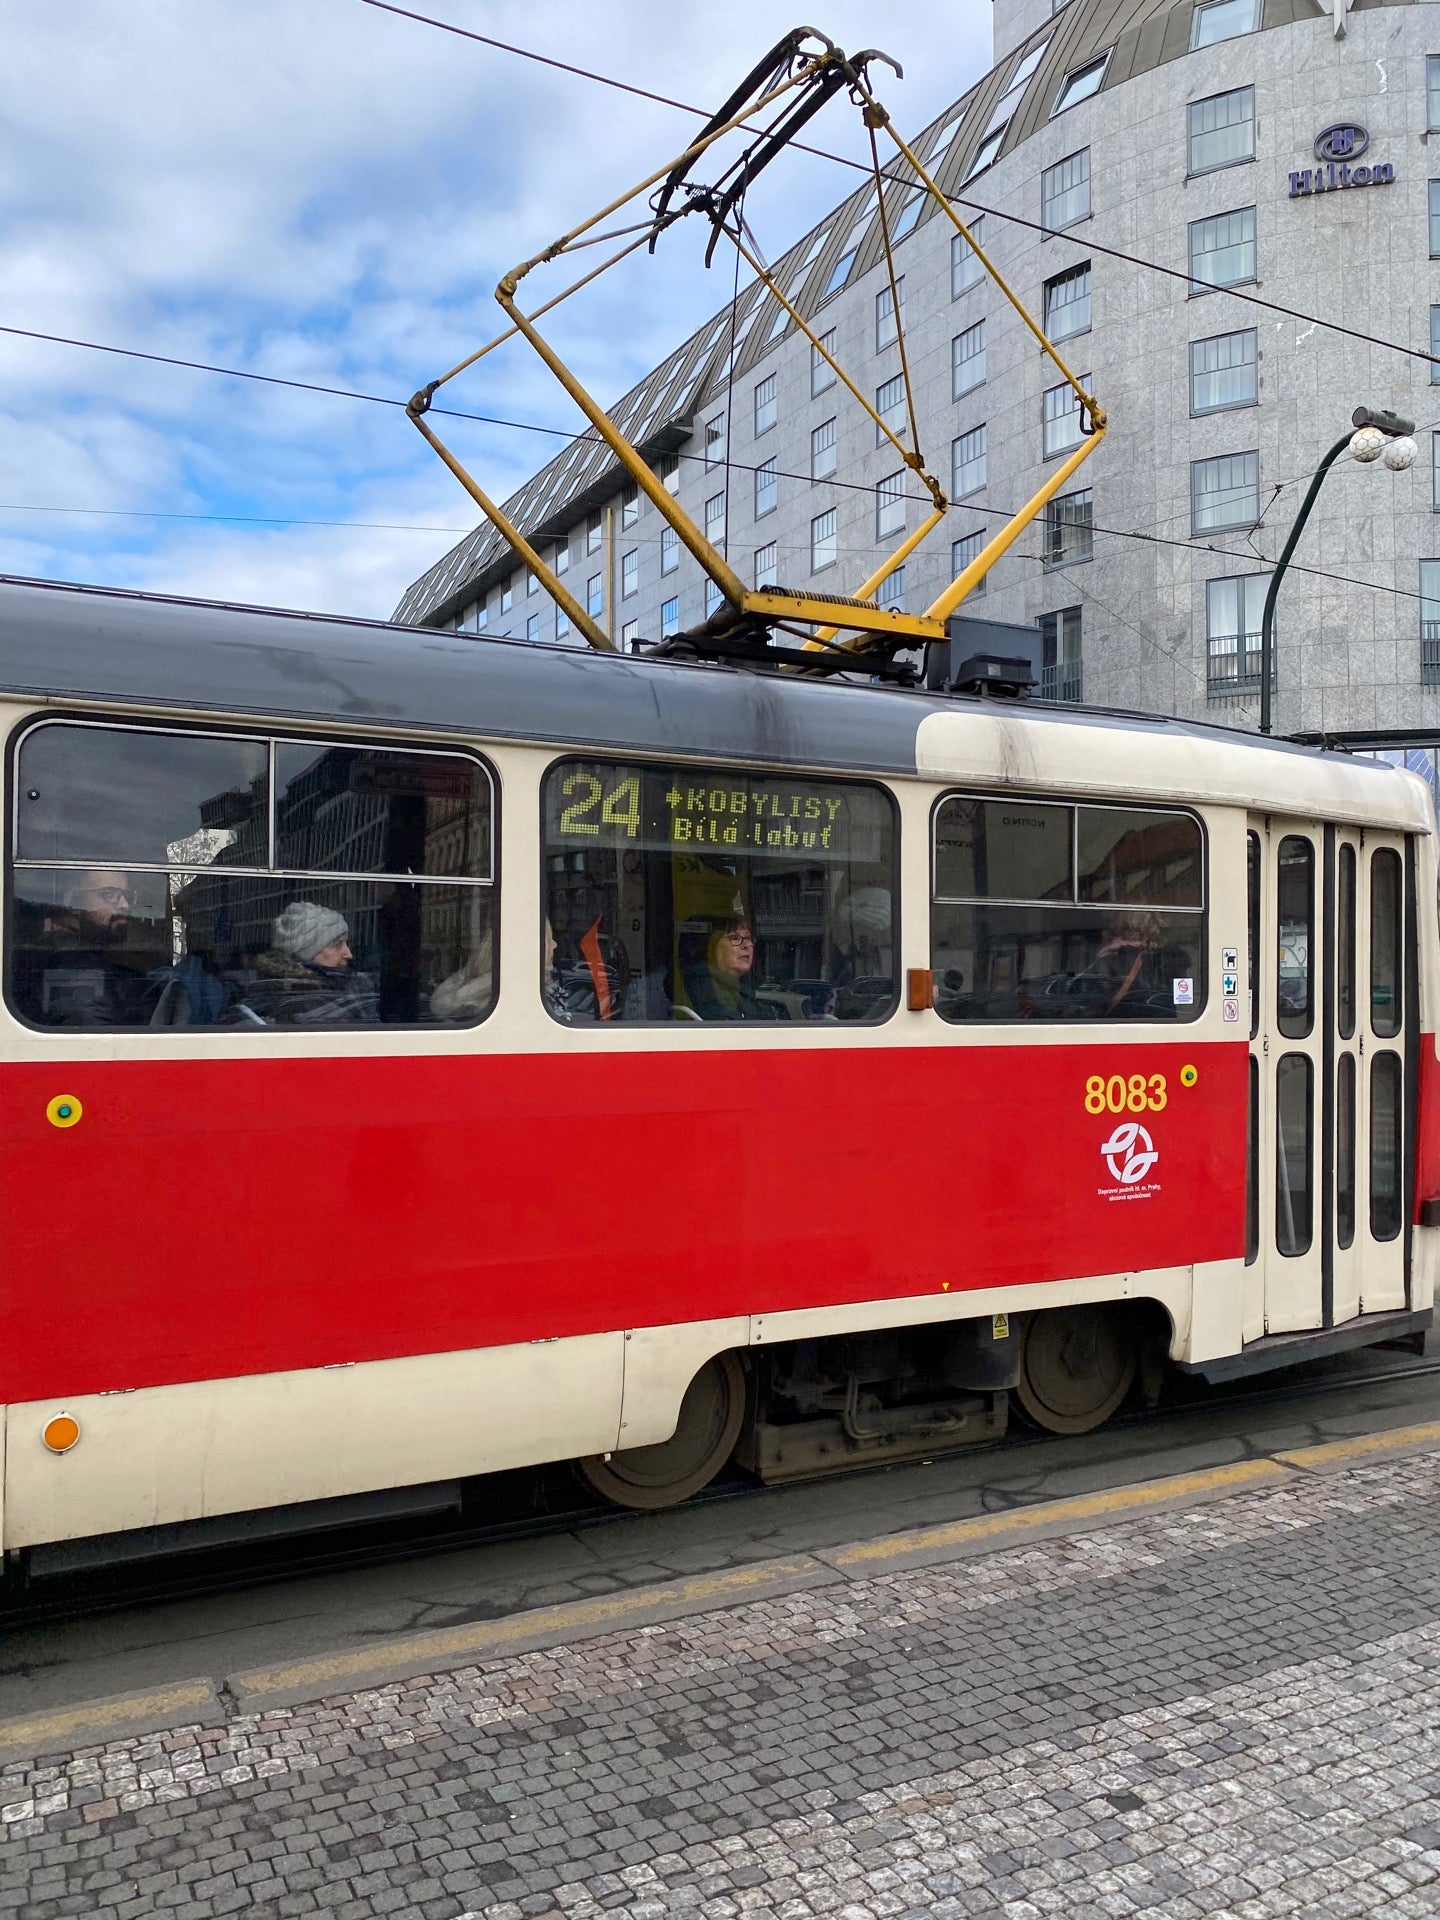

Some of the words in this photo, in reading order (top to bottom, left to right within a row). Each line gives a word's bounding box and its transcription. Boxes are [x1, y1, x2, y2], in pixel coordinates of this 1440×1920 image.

[1288, 162, 1396, 198] Hilton
[560, 772, 641, 837] 24
[687, 787, 842, 821] KOBYLISY
[673, 816, 738, 844] Bílá
[1084, 1073, 1168, 1115] 8083
